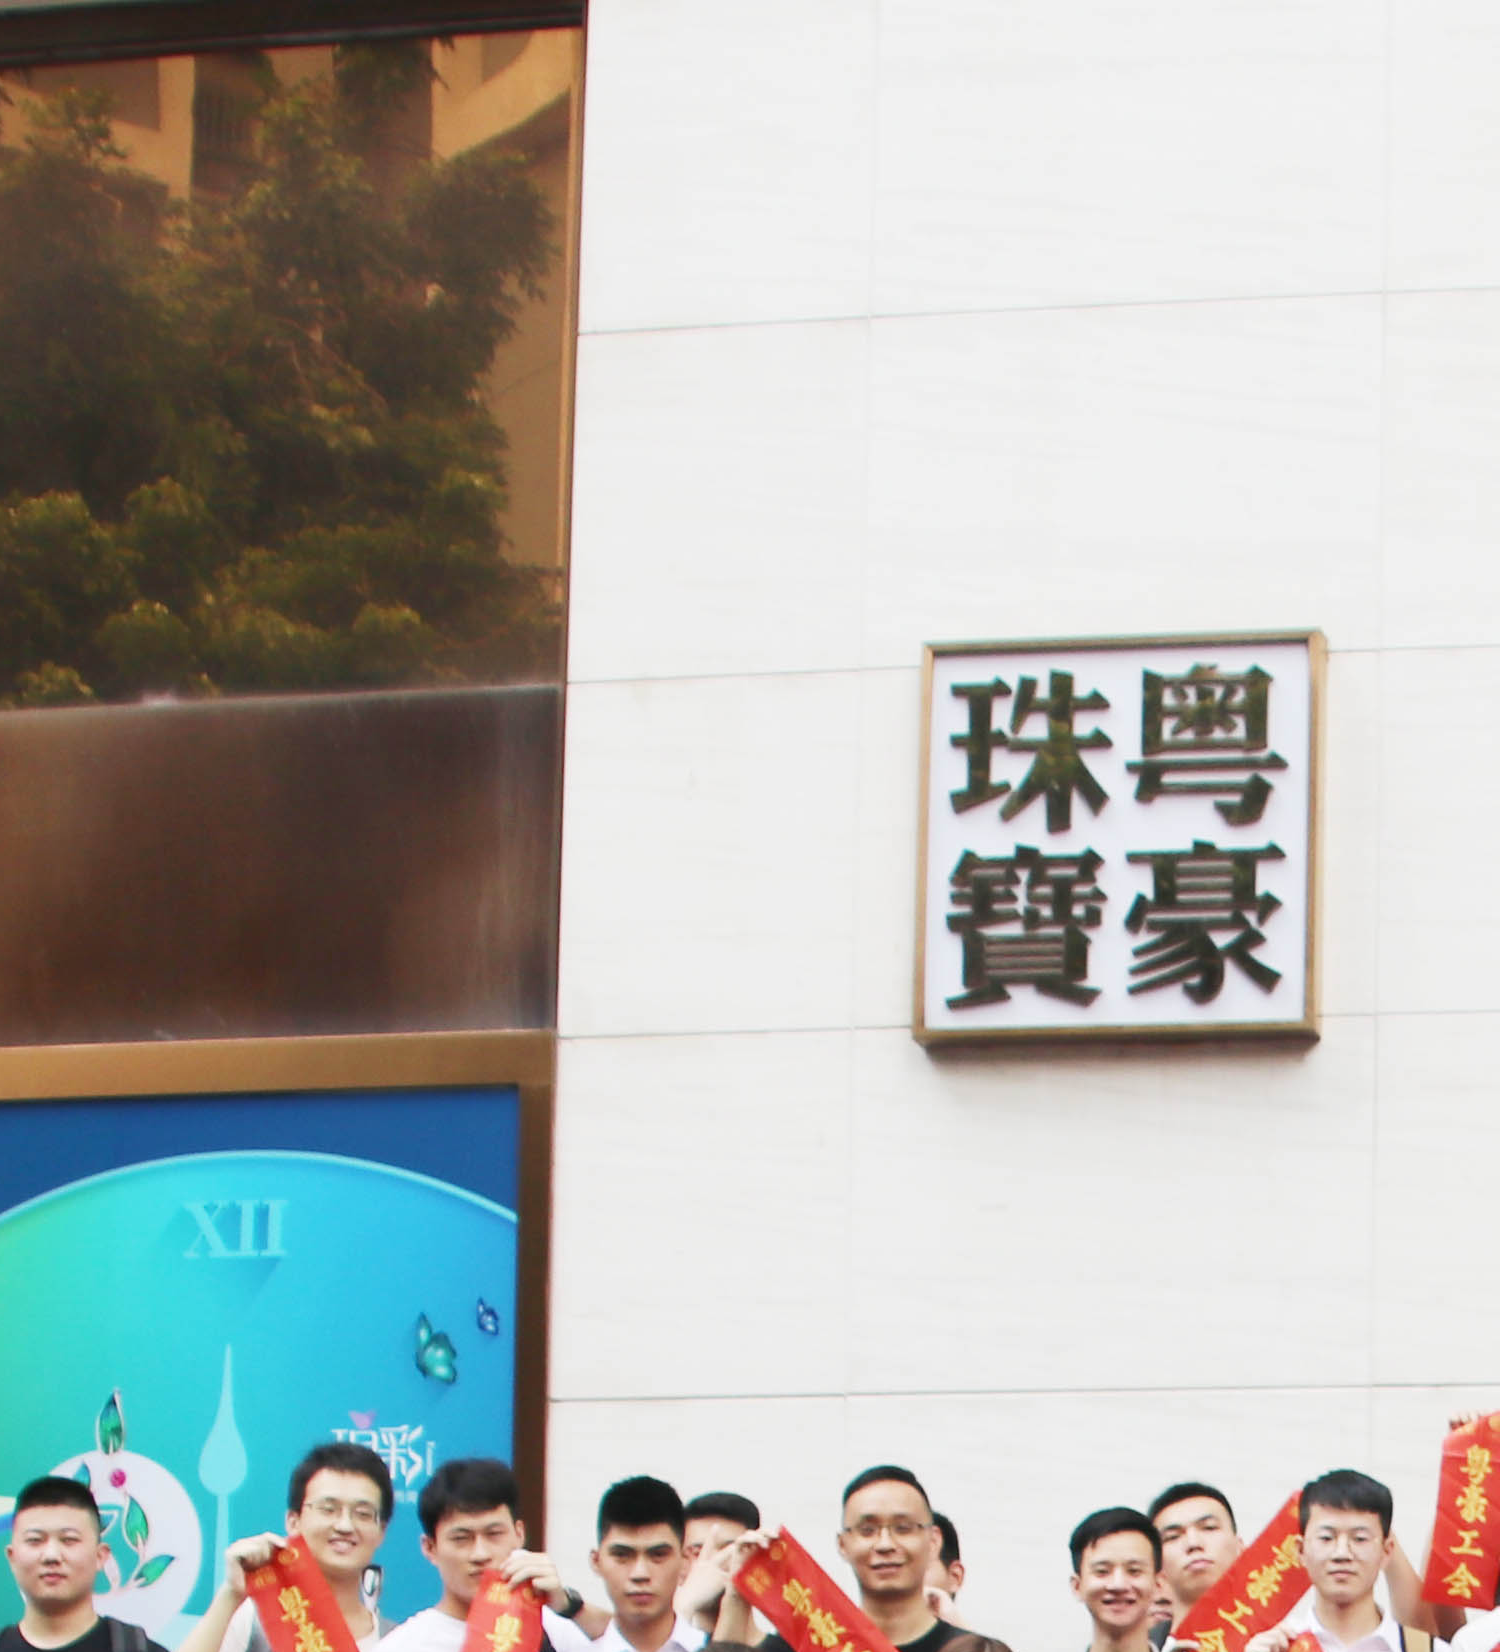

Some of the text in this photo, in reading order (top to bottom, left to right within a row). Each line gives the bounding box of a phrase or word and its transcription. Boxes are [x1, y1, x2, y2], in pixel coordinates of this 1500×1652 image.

[183, 1199, 288, 1258] XII
[1442, 1444, 1493, 1600] 粤豪工会
